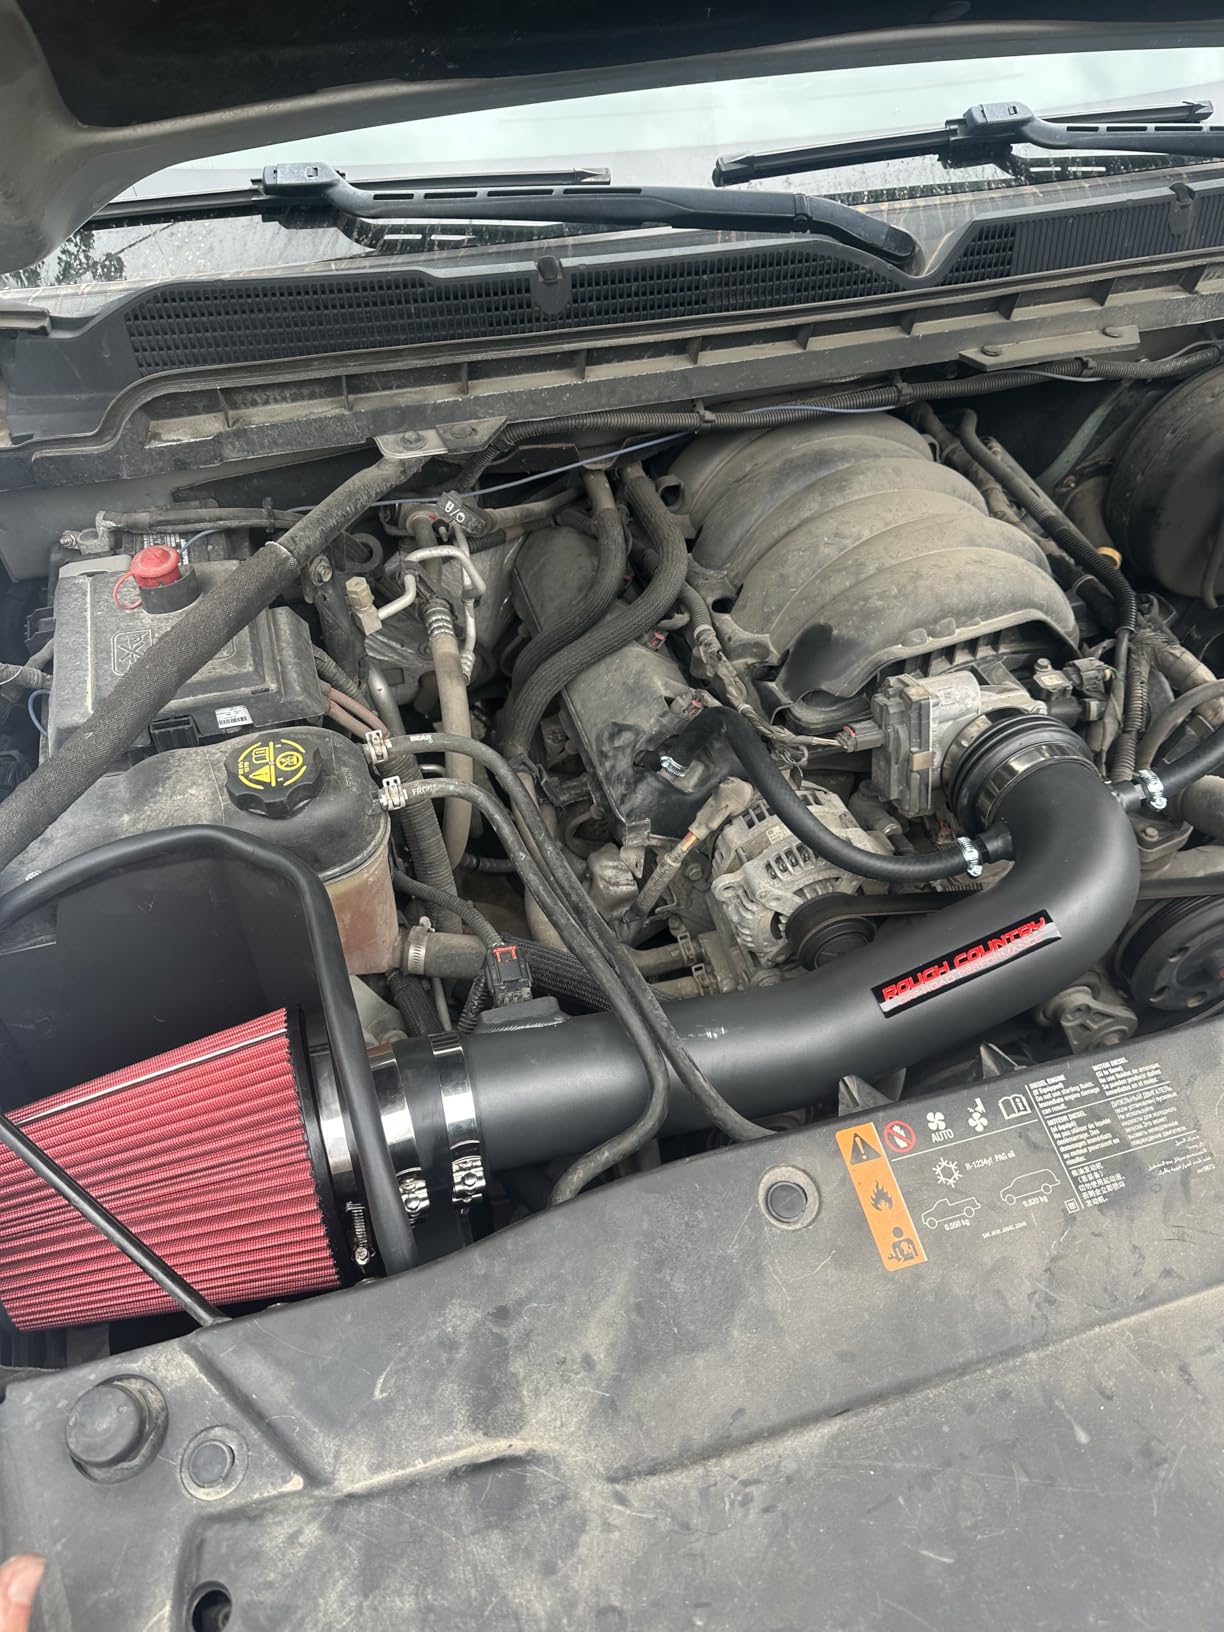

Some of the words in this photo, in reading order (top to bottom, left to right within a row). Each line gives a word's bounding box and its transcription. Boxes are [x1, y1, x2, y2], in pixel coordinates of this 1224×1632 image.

[881, 960, 951, 1002] ROUGH
[953, 916, 1046, 969] COUNTRY
[958, 934, 1042, 978] PERFORMANCE
[931, 1128, 954, 1143] AUTO
[994, 1152, 1008, 1163] PAG
[944, 1220, 962, 1231] 0.550
[961, 1218, 971, 1227] kg
